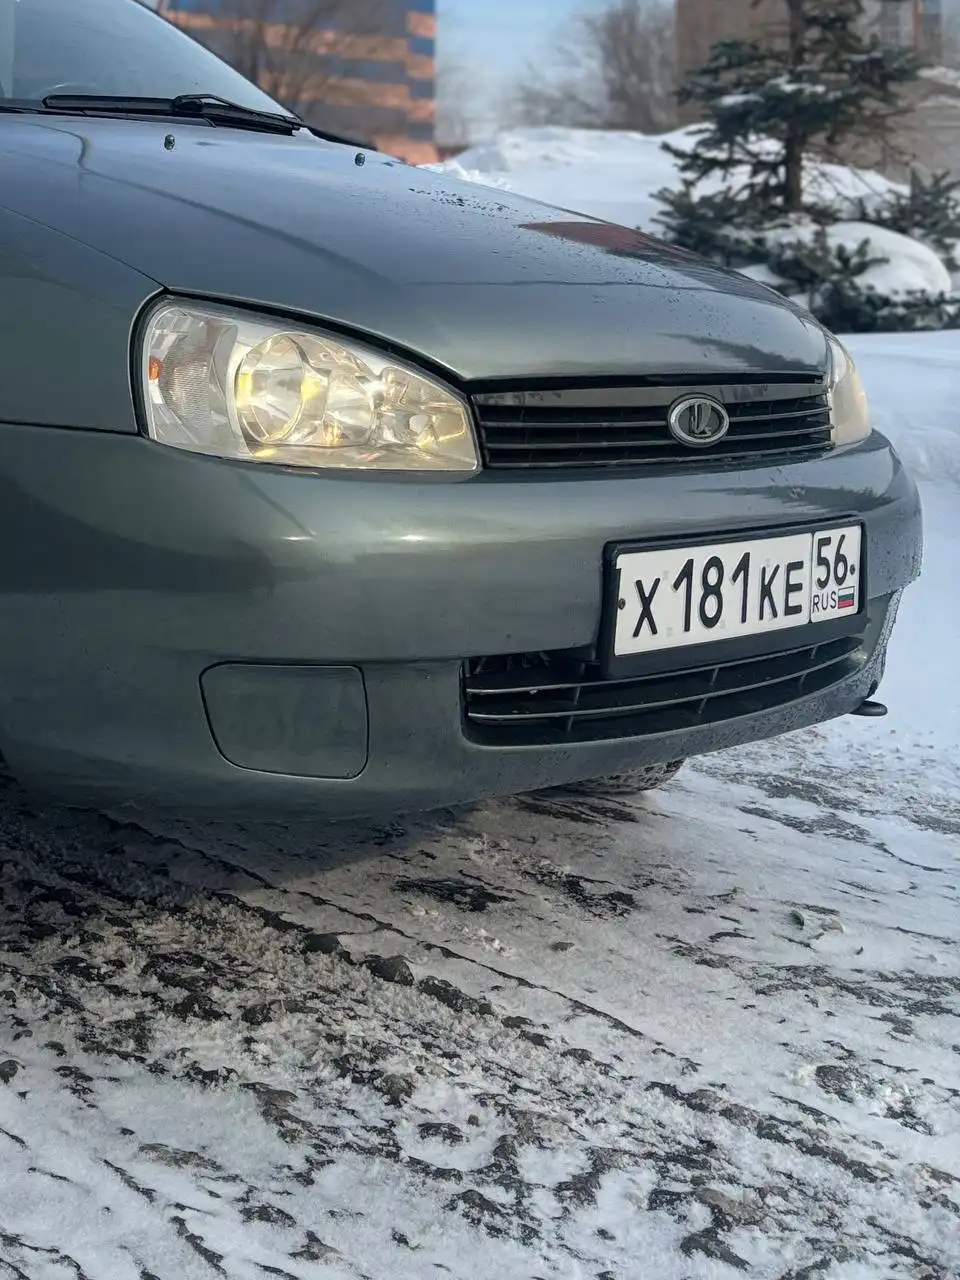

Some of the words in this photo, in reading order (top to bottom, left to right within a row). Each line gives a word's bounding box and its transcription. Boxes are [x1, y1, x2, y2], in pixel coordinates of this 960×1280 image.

[632, 551, 804, 637] Х181КЕ
[816, 534, 848, 589] 56
[812, 591, 837, 613] RUS
